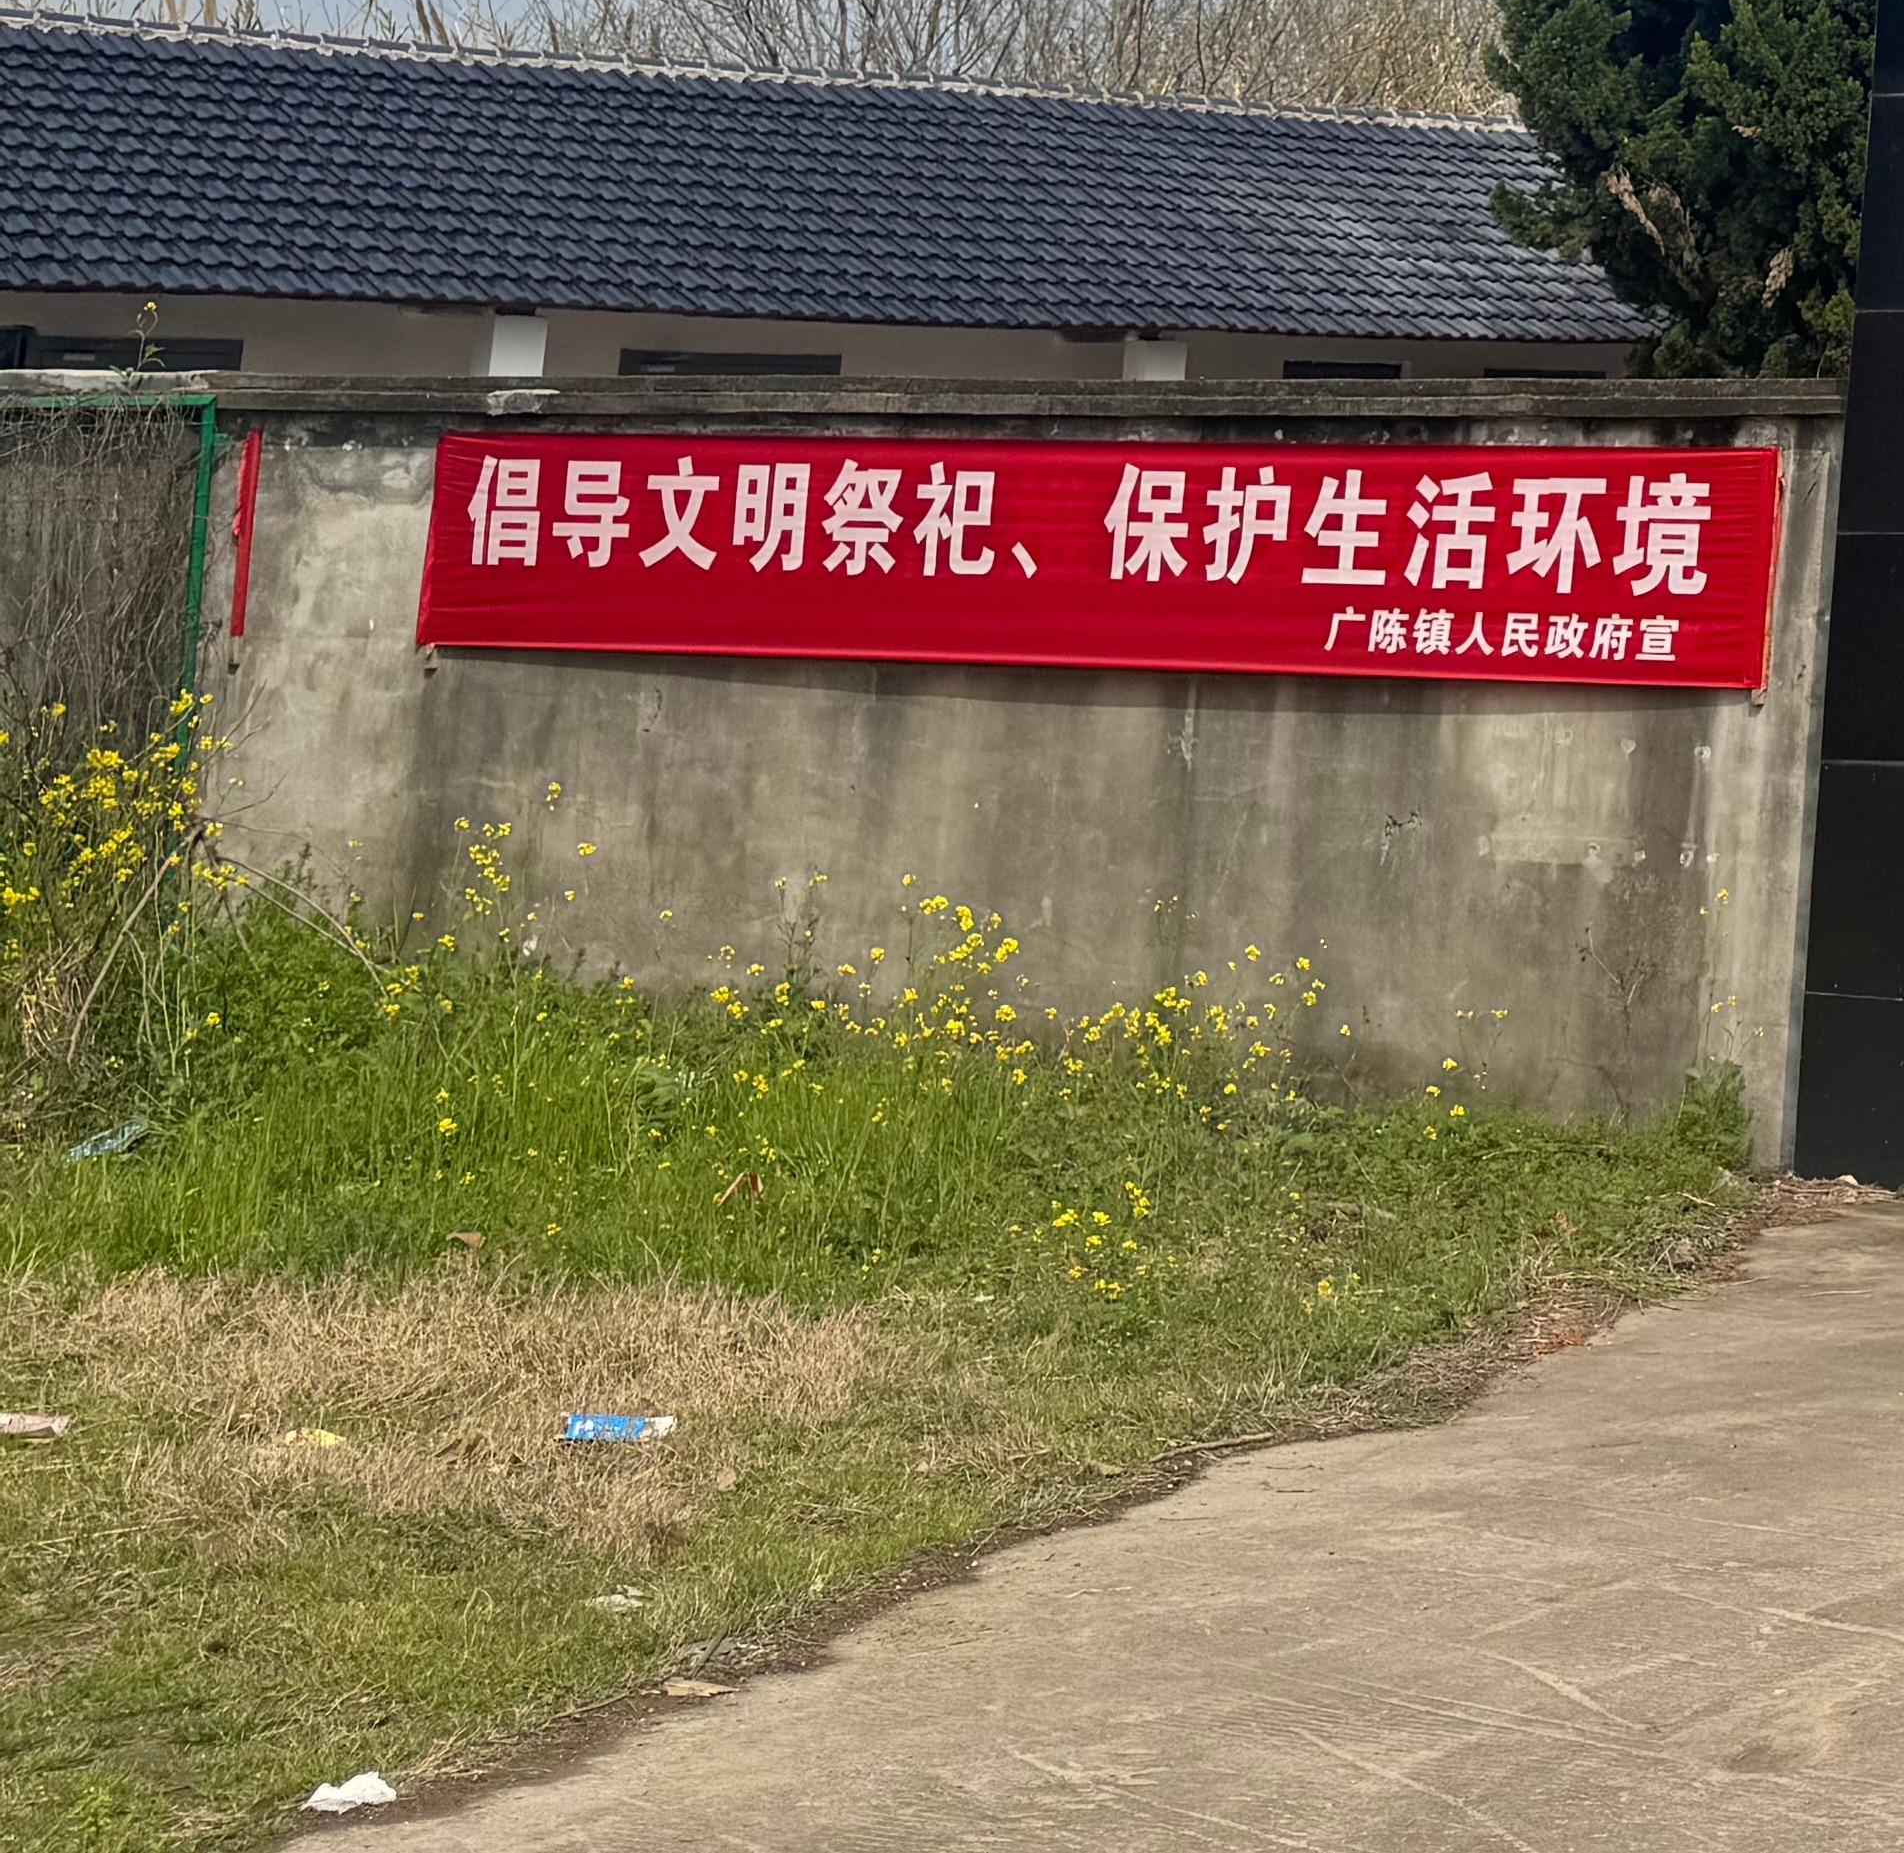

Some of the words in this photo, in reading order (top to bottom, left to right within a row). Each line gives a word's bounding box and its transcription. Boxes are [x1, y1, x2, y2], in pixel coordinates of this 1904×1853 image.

[1324, 606, 1680, 661] 广陈镇人民政府宣
